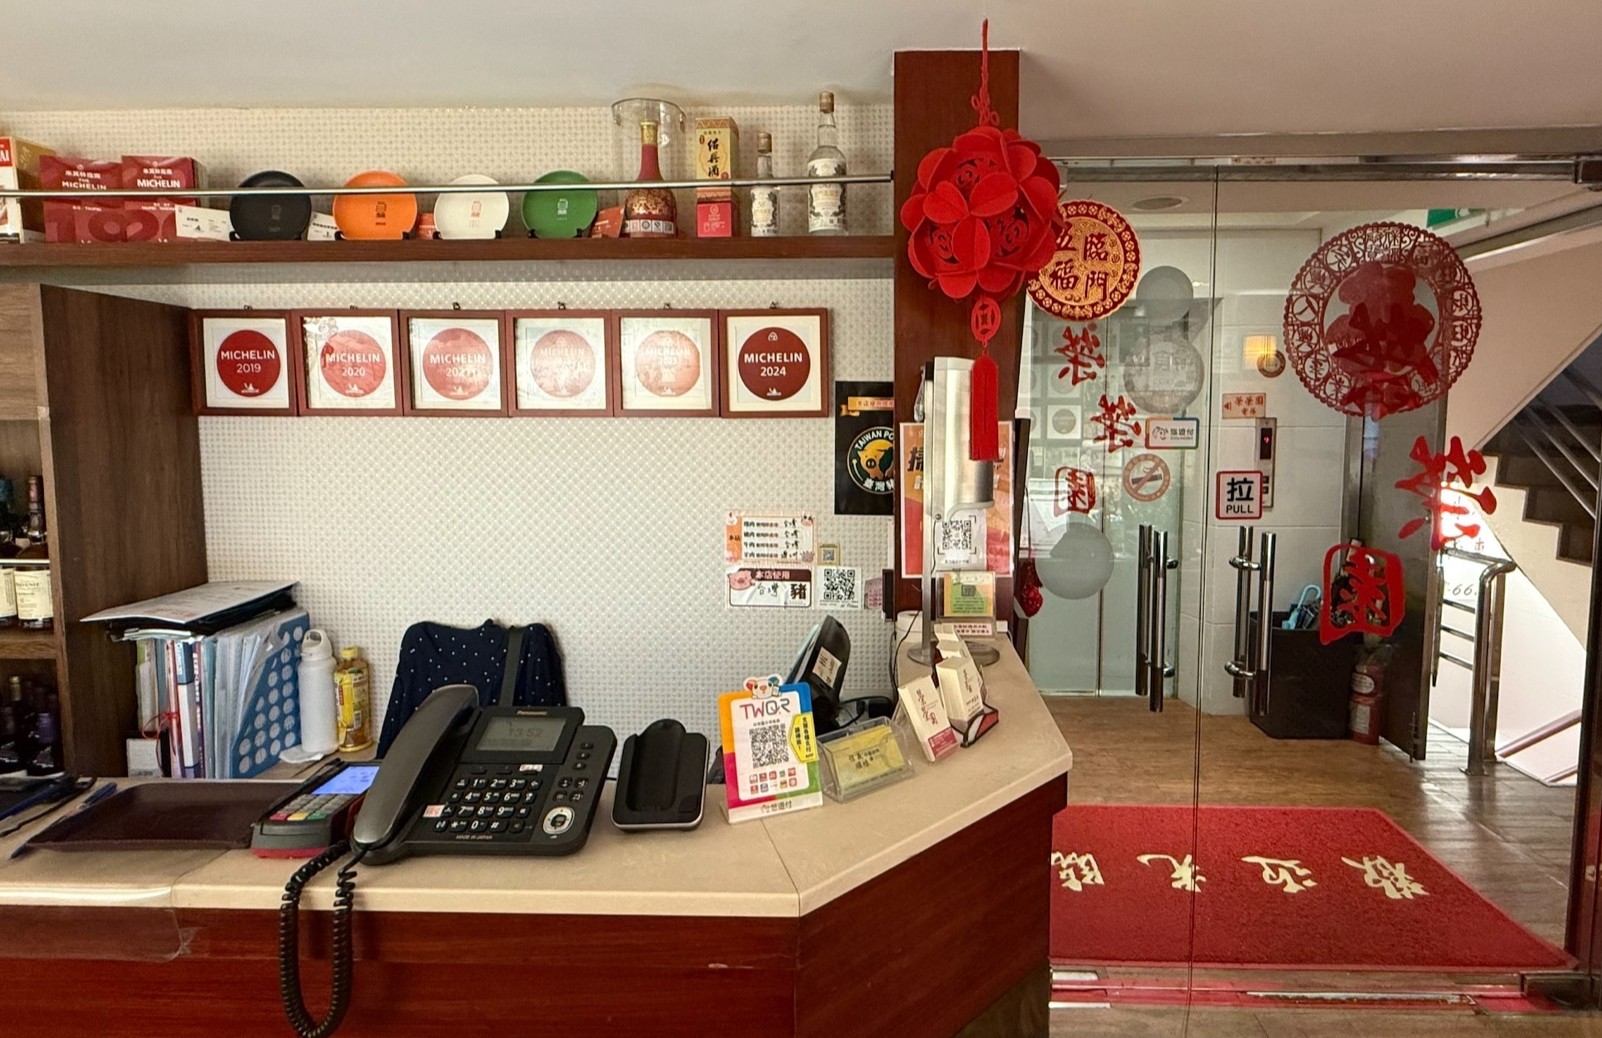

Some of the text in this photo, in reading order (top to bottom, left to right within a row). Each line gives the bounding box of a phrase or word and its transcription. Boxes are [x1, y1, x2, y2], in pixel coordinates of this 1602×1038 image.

[62, 181, 107, 190] MICHELIN
[137, 179, 181, 188] MICHELIN
[220, 350, 275, 361] MICHELIN
[326, 353, 380, 363] MICHELIN
[429, 353, 486, 365] MICHELIN
[744, 352, 803, 364] MICHELIN
[236, 363, 261, 373] 2019
[341, 367, 366, 377] 2020
[760, 366, 787, 377] 2024
[854, 430, 882, 450] TAIWAN
[1226, 477, 1254, 502] 拉
[1226, 504, 1254, 514] PULL
[755, 570, 791, 580] 本店使用
[790, 583, 806, 600] 豬
[739, 698, 791, 719] TWQR
[472, 779, 517, 788] 1 2 3
[465, 792, 511, 801] 4 5 6
[458, 806, 505, 816] 7 8 9
